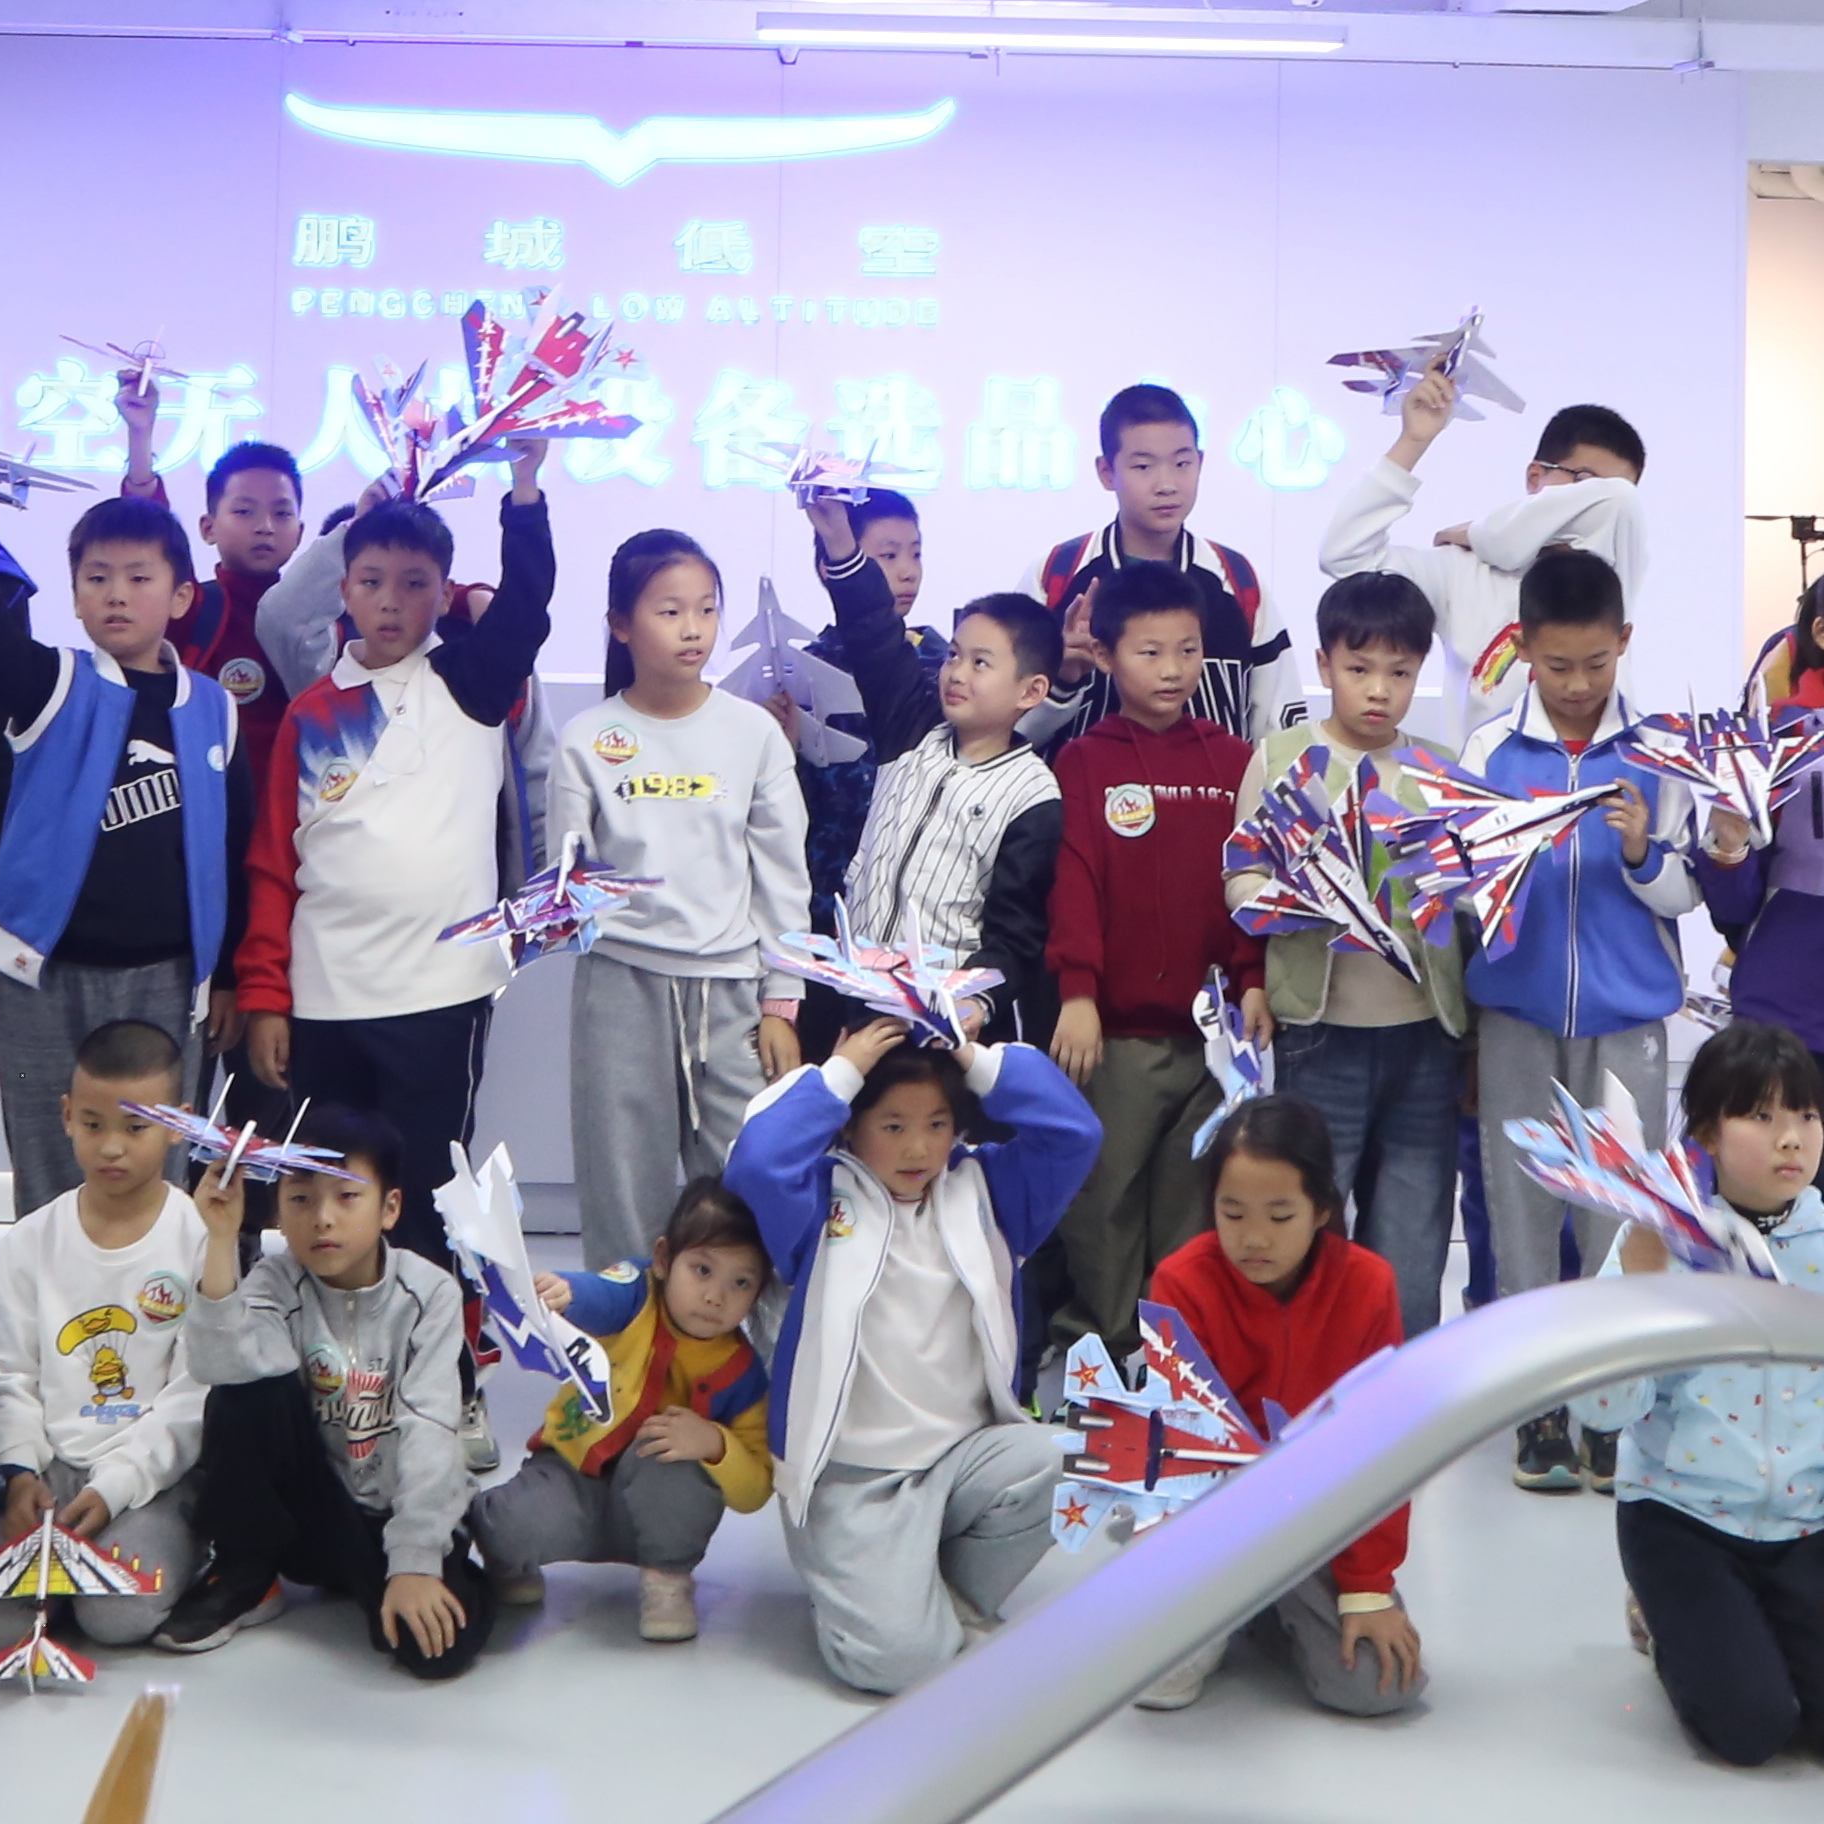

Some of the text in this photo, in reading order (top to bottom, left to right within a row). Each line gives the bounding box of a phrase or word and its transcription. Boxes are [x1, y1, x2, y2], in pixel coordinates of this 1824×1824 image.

[293, 215, 940, 273] 鹏城低空
[591, 294, 685, 321] LOW
[707, 296, 940, 325] ALTITUDE
[100, 768, 181, 831] UMA
